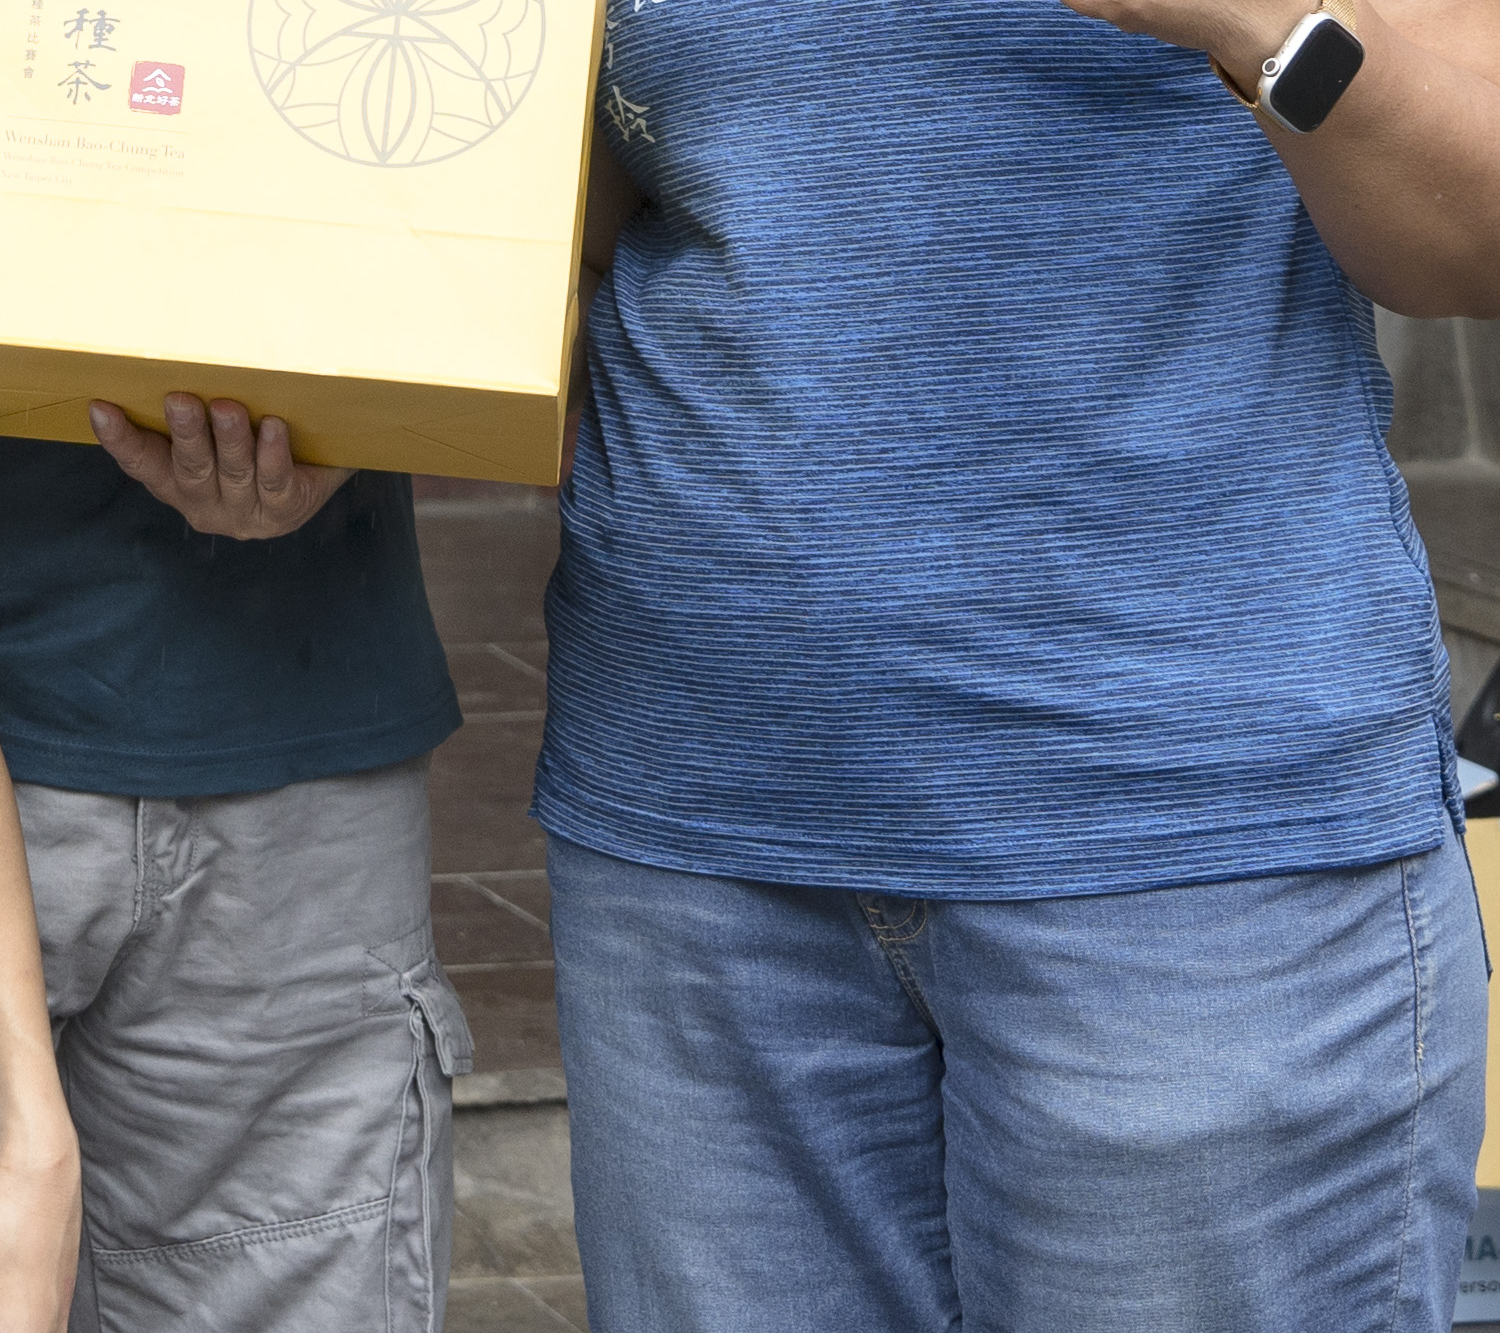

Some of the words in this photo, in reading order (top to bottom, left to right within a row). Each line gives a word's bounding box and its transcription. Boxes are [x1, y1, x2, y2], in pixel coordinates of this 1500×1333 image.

[130, 91, 182, 109] 新北好茶
[4, 128, 72, 150] Wenshan
[75, 135, 160, 161] Bao-Chung
[161, 143, 186, 160] Tea
